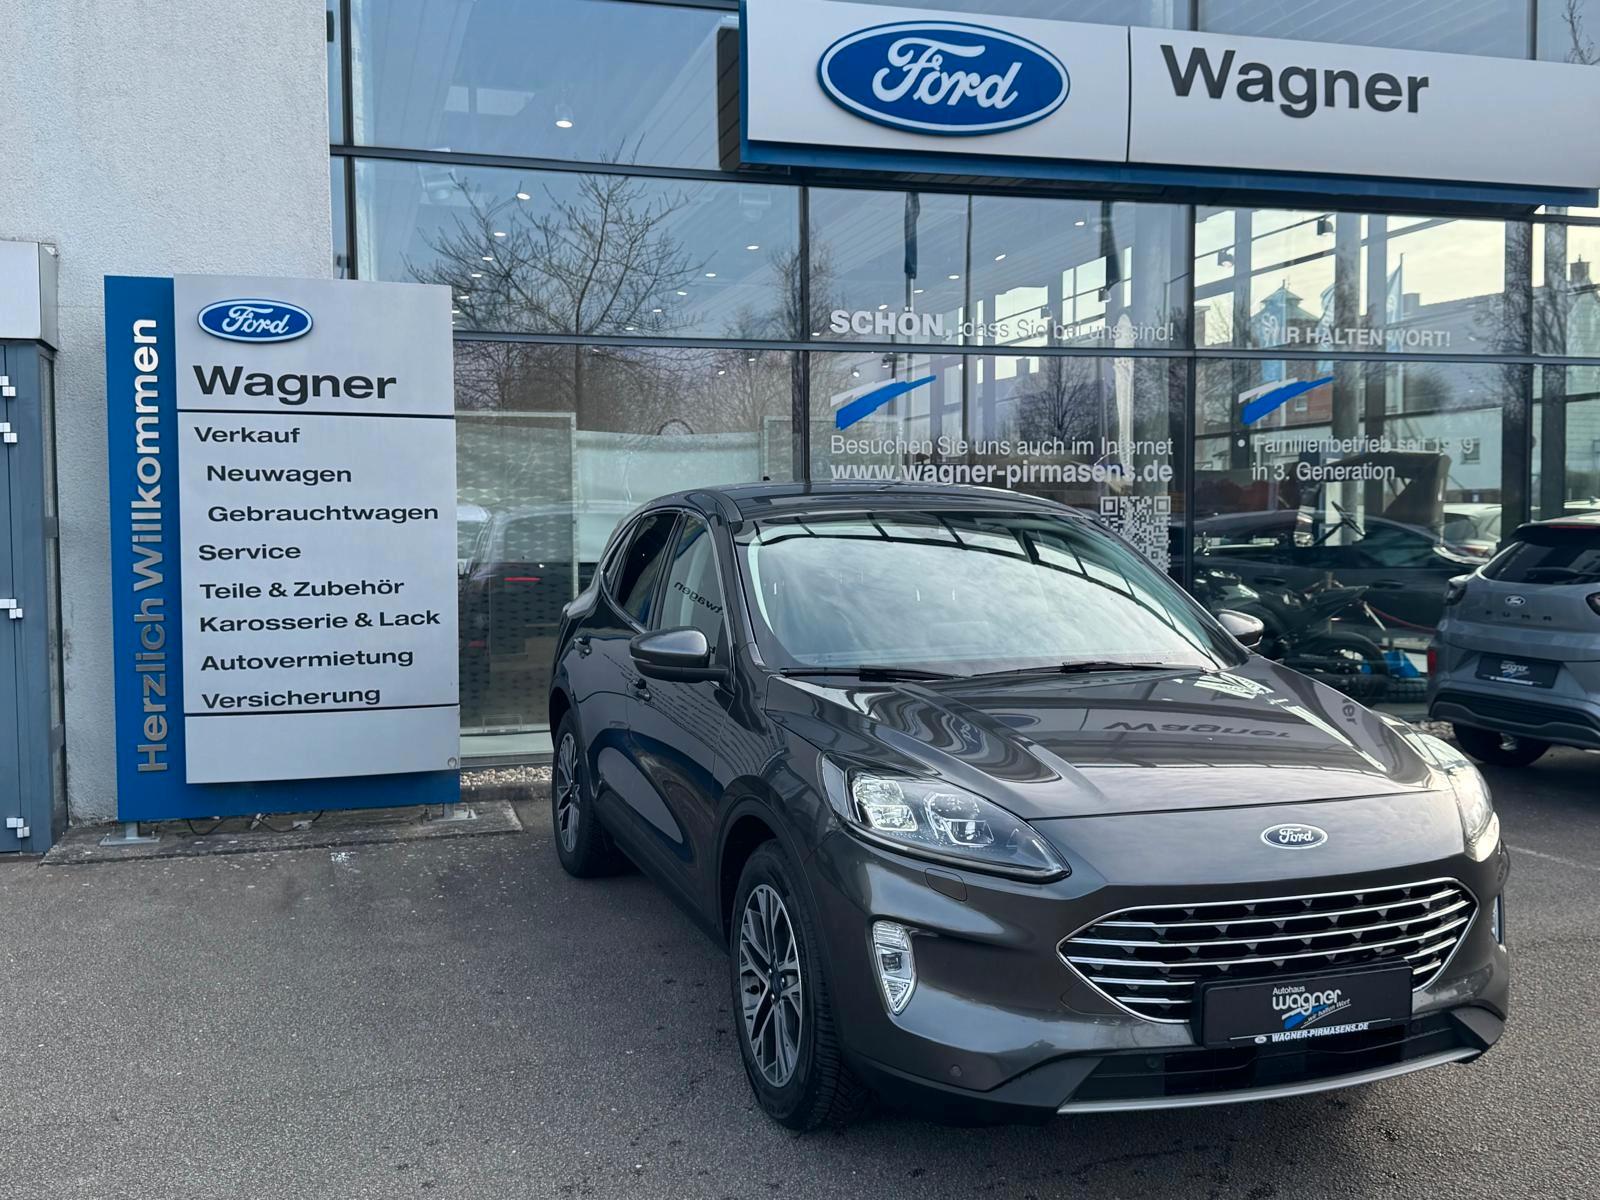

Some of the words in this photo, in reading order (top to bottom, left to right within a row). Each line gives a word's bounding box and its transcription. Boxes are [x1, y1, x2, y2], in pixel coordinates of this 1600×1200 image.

[871, 37, 1023, 110] Ford
[1160, 44, 1429, 118] Wagner
[221, 304, 290, 336] Ford
[829, 306, 953, 340] SCHÖN,
[963, 319, 1009, 339] dass
[1016, 320, 1047, 339] Sie
[1053, 320, 1081, 340] bei
[1089, 325, 1121, 341] uns
[1128, 321, 1175, 342] sind!
[1306, 327, 1383, 346] HALTEN
[1388, 328, 1451, 347] WORT!
[192, 364, 397, 406] Wagner
[194, 426, 301, 443] Verkauf
[1253, 434, 1391, 454] Familienbetrieb
[131, 319, 164, 591] Willkommen
[830, 435, 933, 456] Besuchen
[937, 436, 969, 456] Sie
[974, 441, 1012, 456] uns
[1017, 437, 1066, 456] auch
[1071, 437, 1094, 456] im
[1100, 437, 1174, 457] Internet
[207, 465, 352, 486] Neuwagen
[829, 459, 1174, 489] www.wagner-pirmasens.de
[1252, 462, 1268, 481] in
[1273, 463, 1290, 481] 3.
[1296, 462, 1395, 482] Generation
[207, 506, 439, 524] Gebrauchtwagen
[198, 544, 301, 561] Service
[200, 582, 262, 599] Teile
[268, 582, 288, 598] &
[293, 579, 405, 598] Zubehör
[200, 613, 348, 632] Karosserie
[354, 611, 374, 628] &
[379, 610, 441, 627] Lack
[201, 651, 414, 672] Autovermietung
[134, 598, 168, 772] Herzlich
[202, 688, 381, 709] Versicherung
[1278, 826, 1315, 844] Ford
[1272, 985, 1306, 995] Autohaus
[1272, 989, 1342, 1016] wagner
[1272, 1022, 1369, 1043] WAGNER-PIRMASENS.DE
